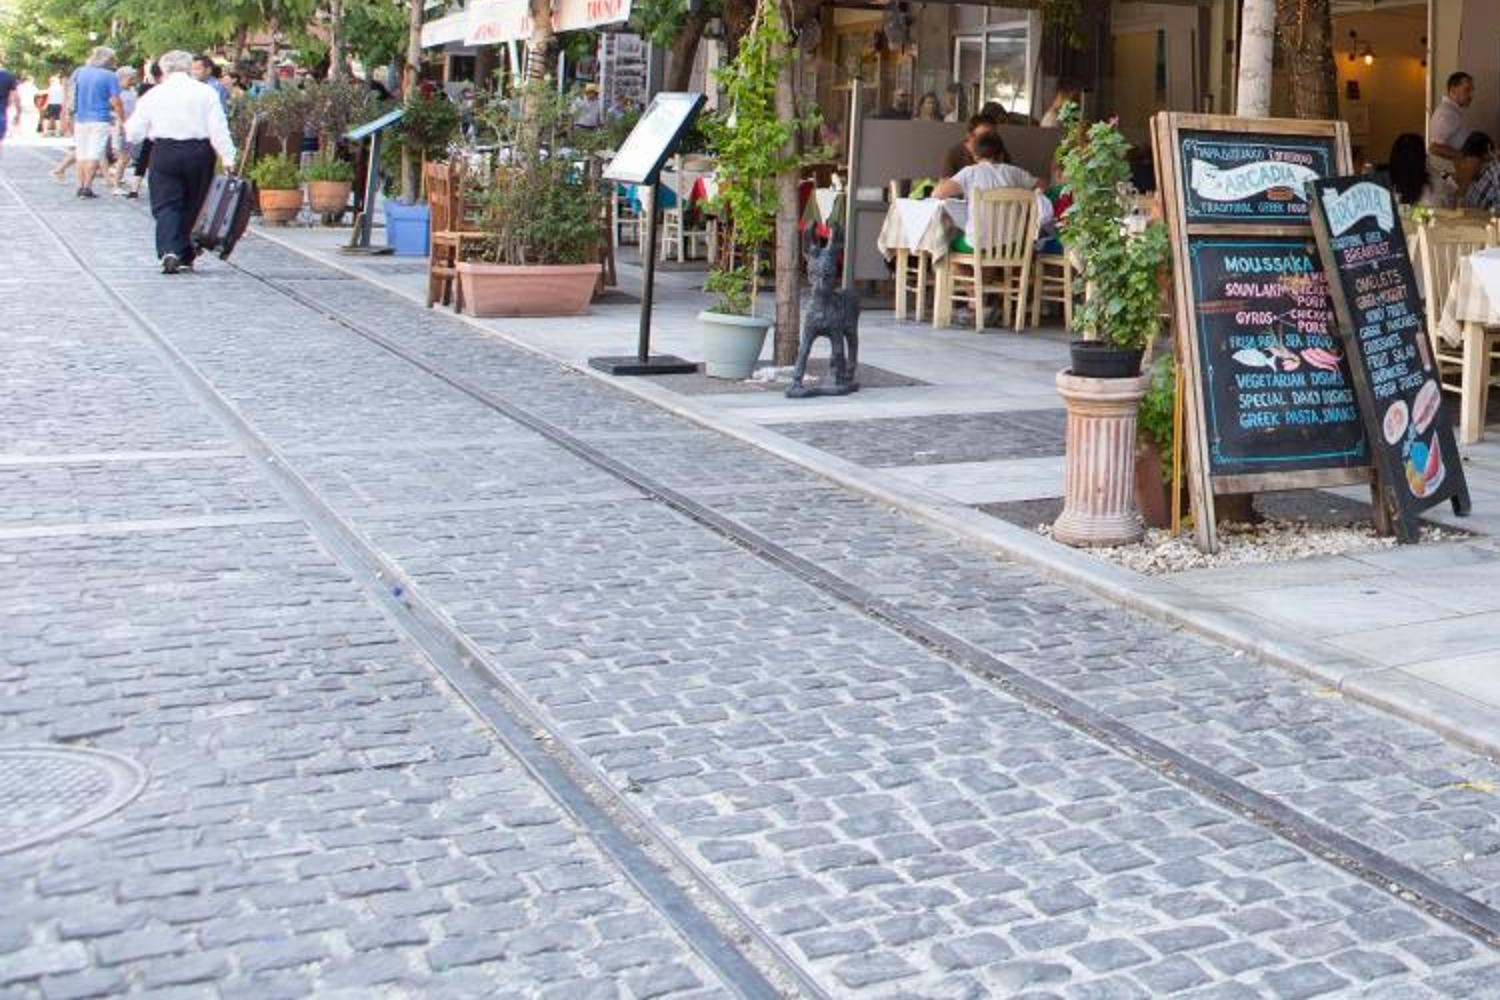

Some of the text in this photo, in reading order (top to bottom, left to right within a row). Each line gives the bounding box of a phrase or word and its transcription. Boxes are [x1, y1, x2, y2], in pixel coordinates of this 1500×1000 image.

[1225, 165, 1296, 193] ARCADIA
[1257, 201, 1284, 213] GREEK
[1343, 241, 1390, 263] BREAKFAST
[1223, 256, 1313, 273] MOUSSAKA
[1224, 284, 1281, 297] SOUVLAKI
[1297, 295, 1327, 307] PORK
[1235, 311, 1273, 325] GYROS
[1297, 320, 1328, 334] PORK
[1235, 373, 1307, 389] VEGETARIAN
[1239, 393, 1286, 408] SPECIAL
[1239, 411, 1281, 429] GREEK
